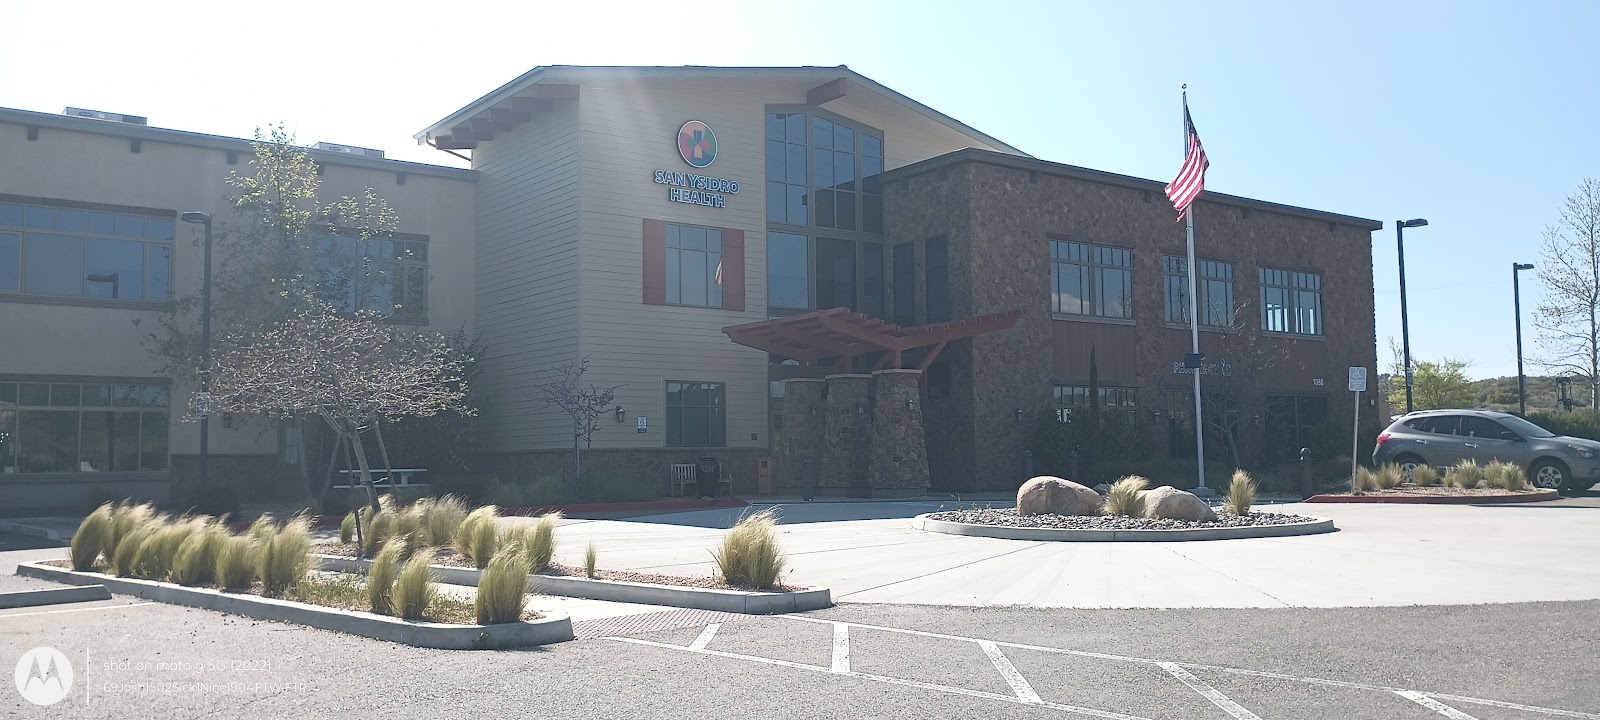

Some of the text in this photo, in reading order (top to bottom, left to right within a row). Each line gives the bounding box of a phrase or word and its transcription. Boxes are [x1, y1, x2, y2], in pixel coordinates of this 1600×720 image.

[653, 169, 740, 194] SAN YSIDRO
[669, 187, 726, 208] HEALTH
